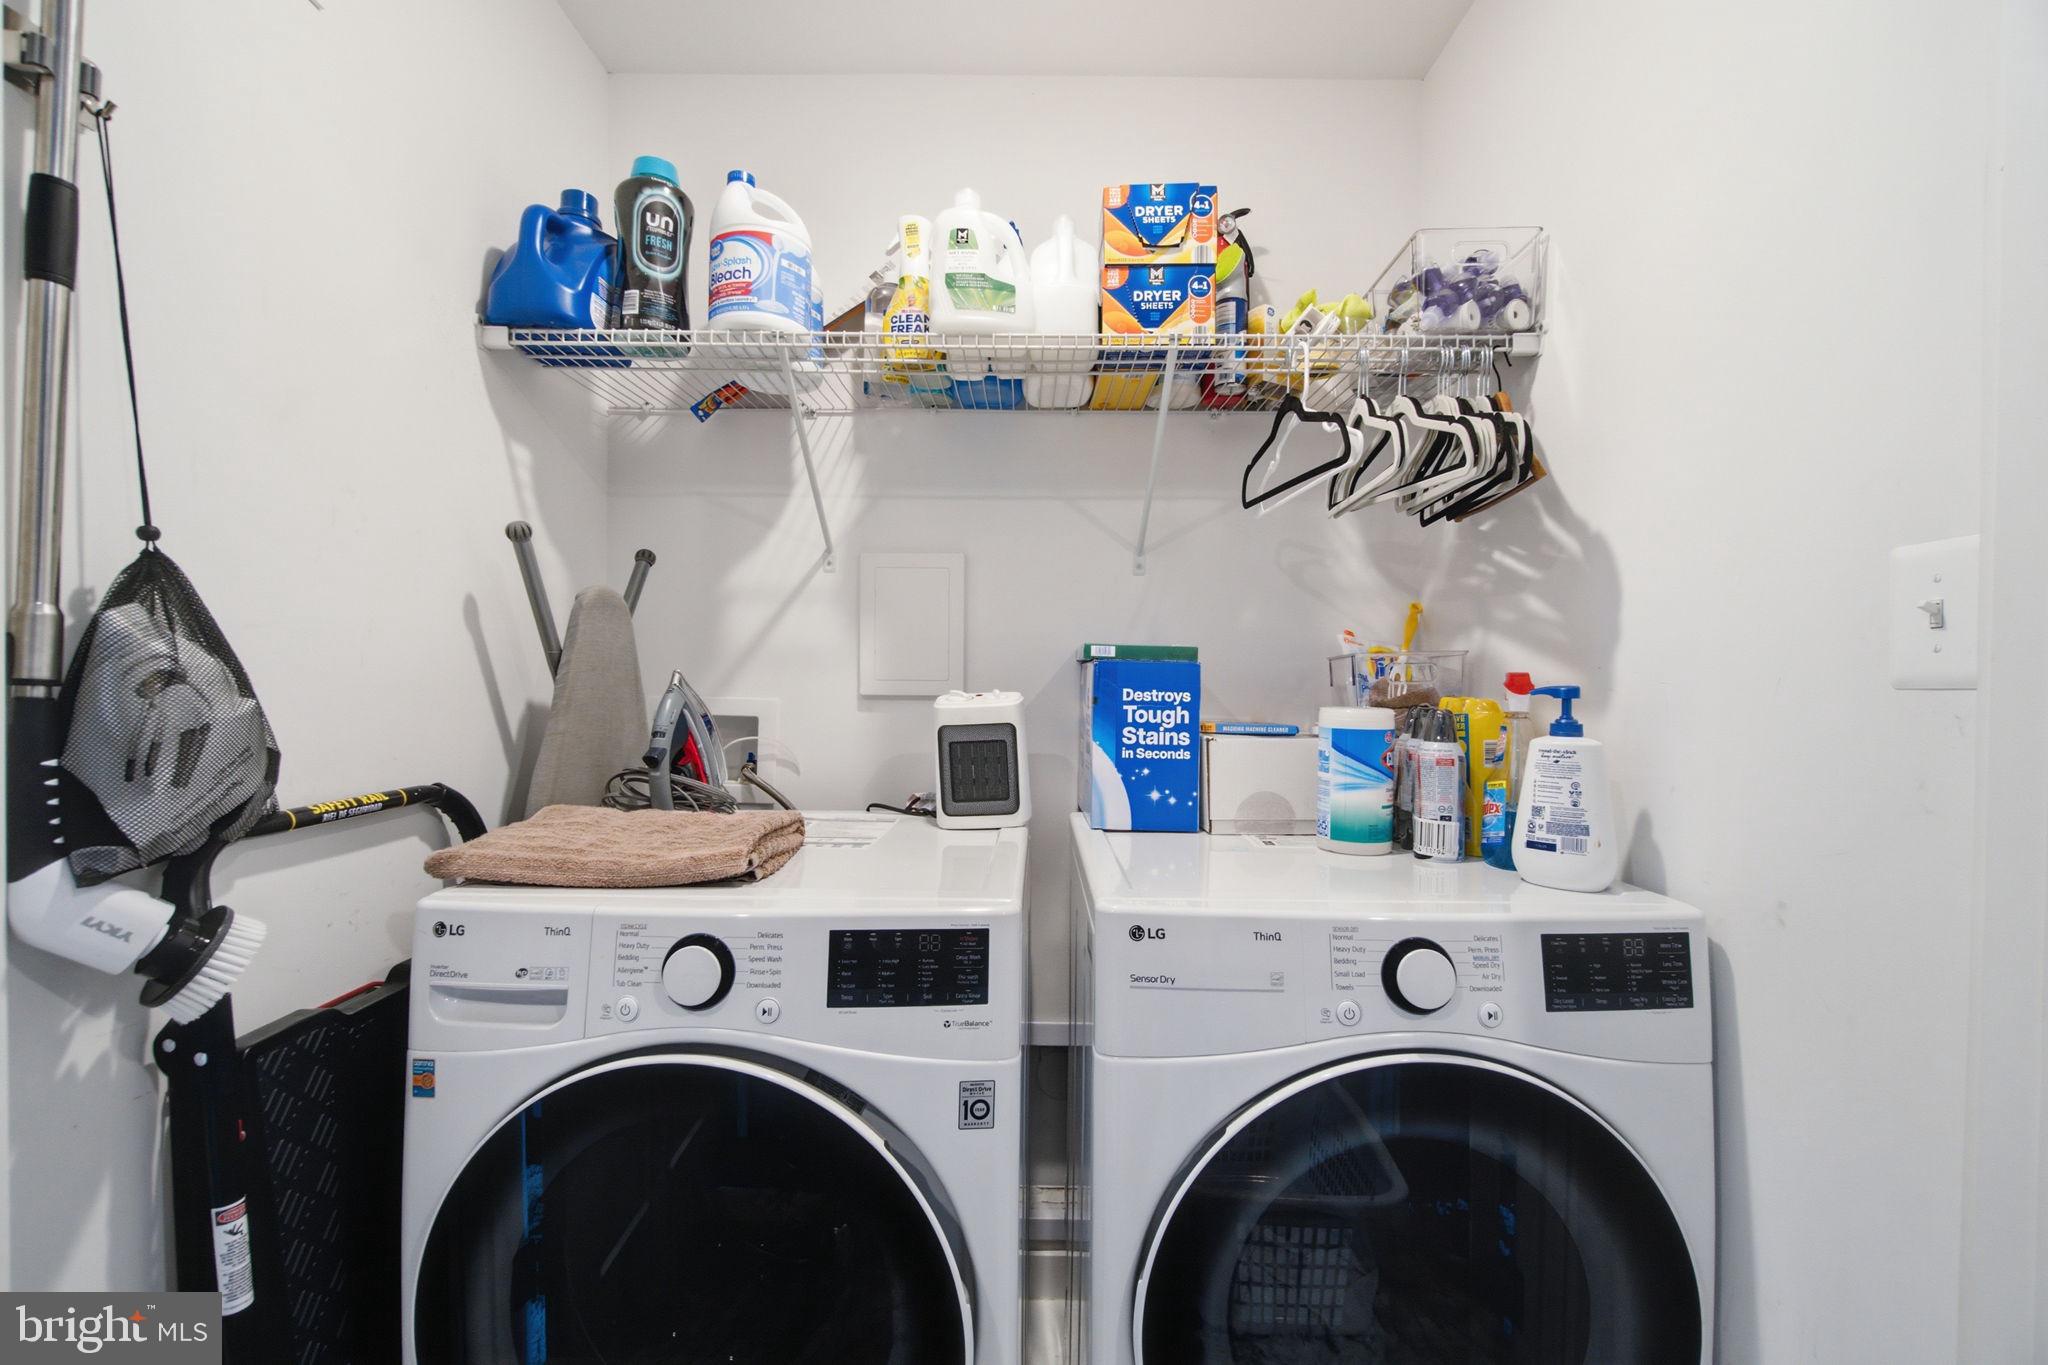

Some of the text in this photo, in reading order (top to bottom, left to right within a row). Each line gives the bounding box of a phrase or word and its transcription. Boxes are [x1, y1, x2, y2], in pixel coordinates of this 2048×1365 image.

[1134, 205, 1183, 217] DRYER
[1142, 216, 1176, 224] SHEETS
[644, 234, 673, 252] FRESH
[711, 266, 752, 286] Bleach
[1133, 290, 1182, 302] DRYER
[1140, 302, 1174, 310] SHEETS
[890, 314, 930, 325] CLEAN
[890, 324, 930, 333] FREAK
[1122, 687, 1192, 706] Destroys
[1122, 705, 1190, 729] Tough
[1121, 726, 1191, 746] Stains
[1121, 747, 1191, 760] in Seconds
[309, 792, 389, 815] SAFETY RAIL
[449, 924, 465, 936] LG
[543, 926, 571, 936] ThinQ
[757, 931, 784, 939] Delicates
[1147, 928, 1166, 940] LG
[1252, 931, 1282, 942] ThinQ
[766, 943, 783, 951] Press
[1351, 946, 1366, 954] Duty
[617, 954, 640, 962] Bedding
[748, 955, 766, 963] Speed
[1333, 957, 1357, 965] Bedding
[1472, 961, 1500, 969] Speed Dry
[1334, 970, 1350, 978] Small
[1482, 972, 1500, 981] Air Dry
[746, 981, 782, 989] Downloaded
[1335, 983, 1354, 991] Towels
[962, 1099, 991, 1121] 10
